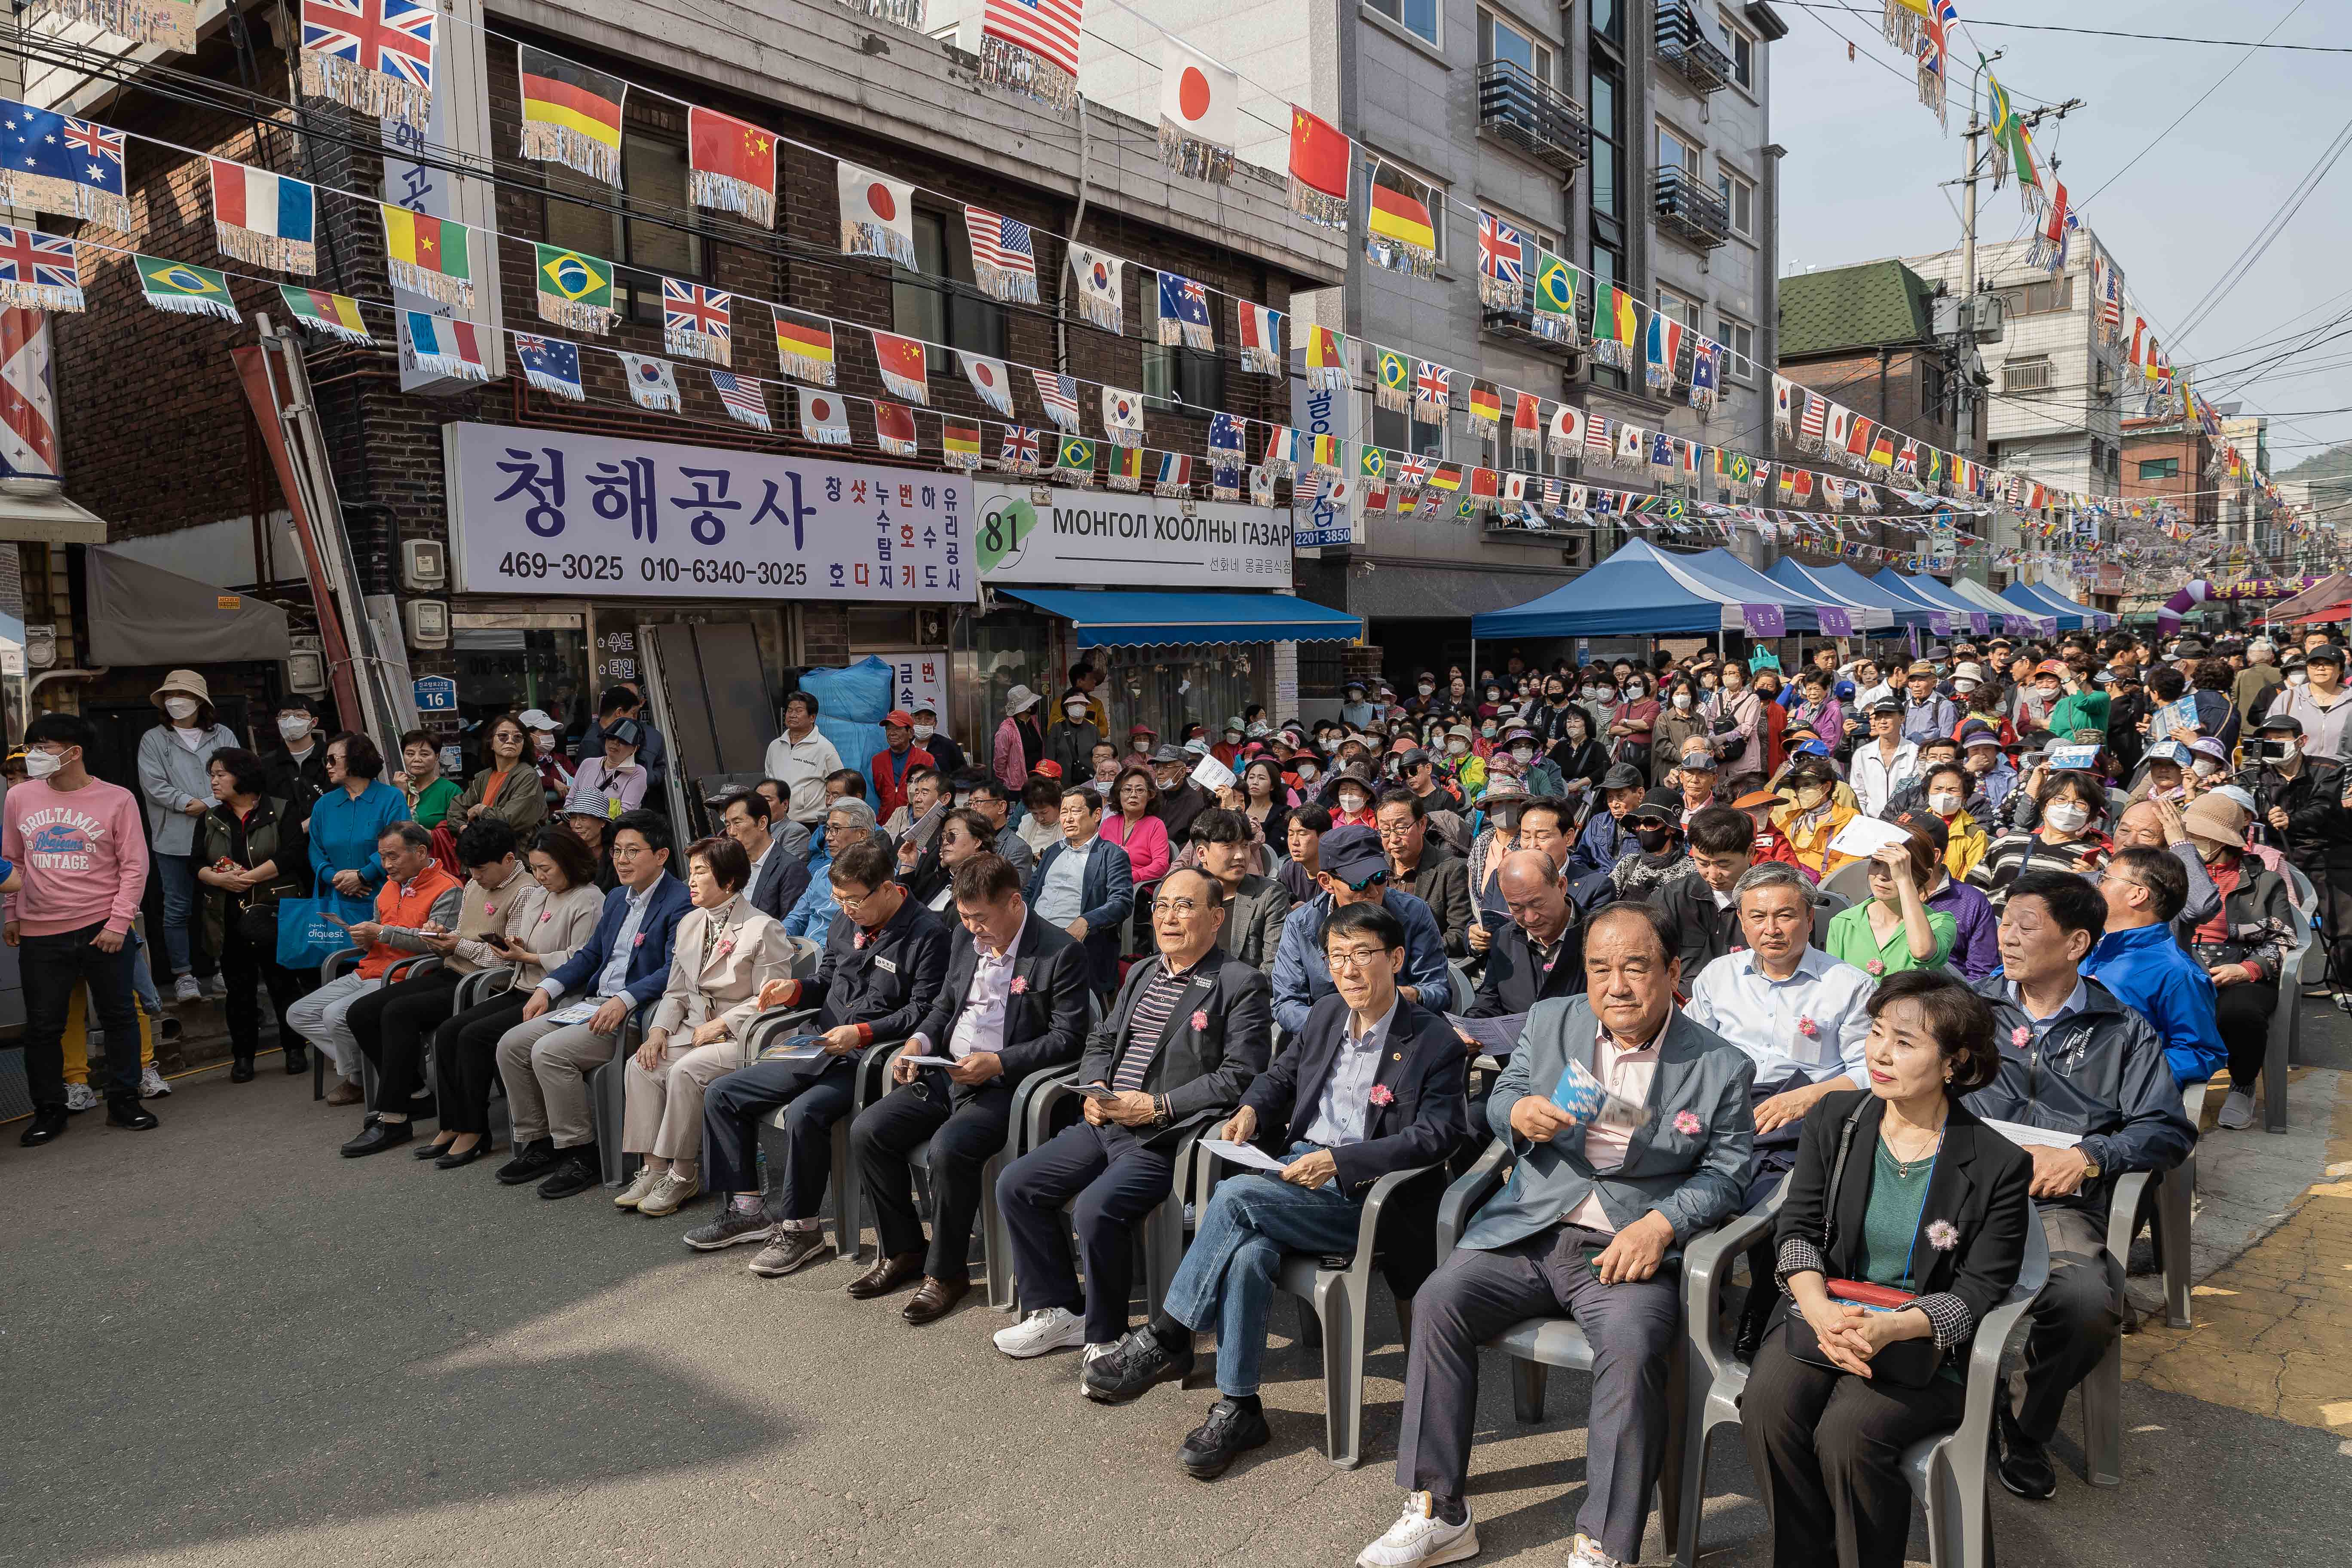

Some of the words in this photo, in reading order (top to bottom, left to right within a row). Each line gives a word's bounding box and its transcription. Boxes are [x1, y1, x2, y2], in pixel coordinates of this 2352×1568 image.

[494, 446, 818, 551] 청해공사
[876, 481, 893, 589] 누수탐지
[899, 484, 916, 588] 번호키
[922, 486, 939, 588] 하수도
[943, 488, 961, 591] 유리공사
[985, 511, 1020, 552] 81
[1053, 508, 1147, 539] МОНГОЛ
[1154, 514, 1236, 544] ХООЛНЫ
[1243, 521, 1290, 548] ГАЗАР
[1296, 530, 1350, 545] 2201-3850
[499, 552, 623, 581] 469-3025
[641, 557, 807, 585] 010-6340-3025
[1210, 557, 1239, 573] 선화네
[1245, 558, 1291, 574] 몽골음식점
[608, 633, 634, 652] 수도
[609, 658, 635, 678] 타일
[426, 693, 444, 706] 16
[900, 663, 914, 708] 금속
[20, 807, 106, 841] BRULTAMIA
[25, 840, 34, 850] 19
[86, 843, 97, 853] 61
[33, 854, 89, 870] VINTAGE
[308, 928, 344, 940] diquest
[671, 1173, 682, 1182] ecco
